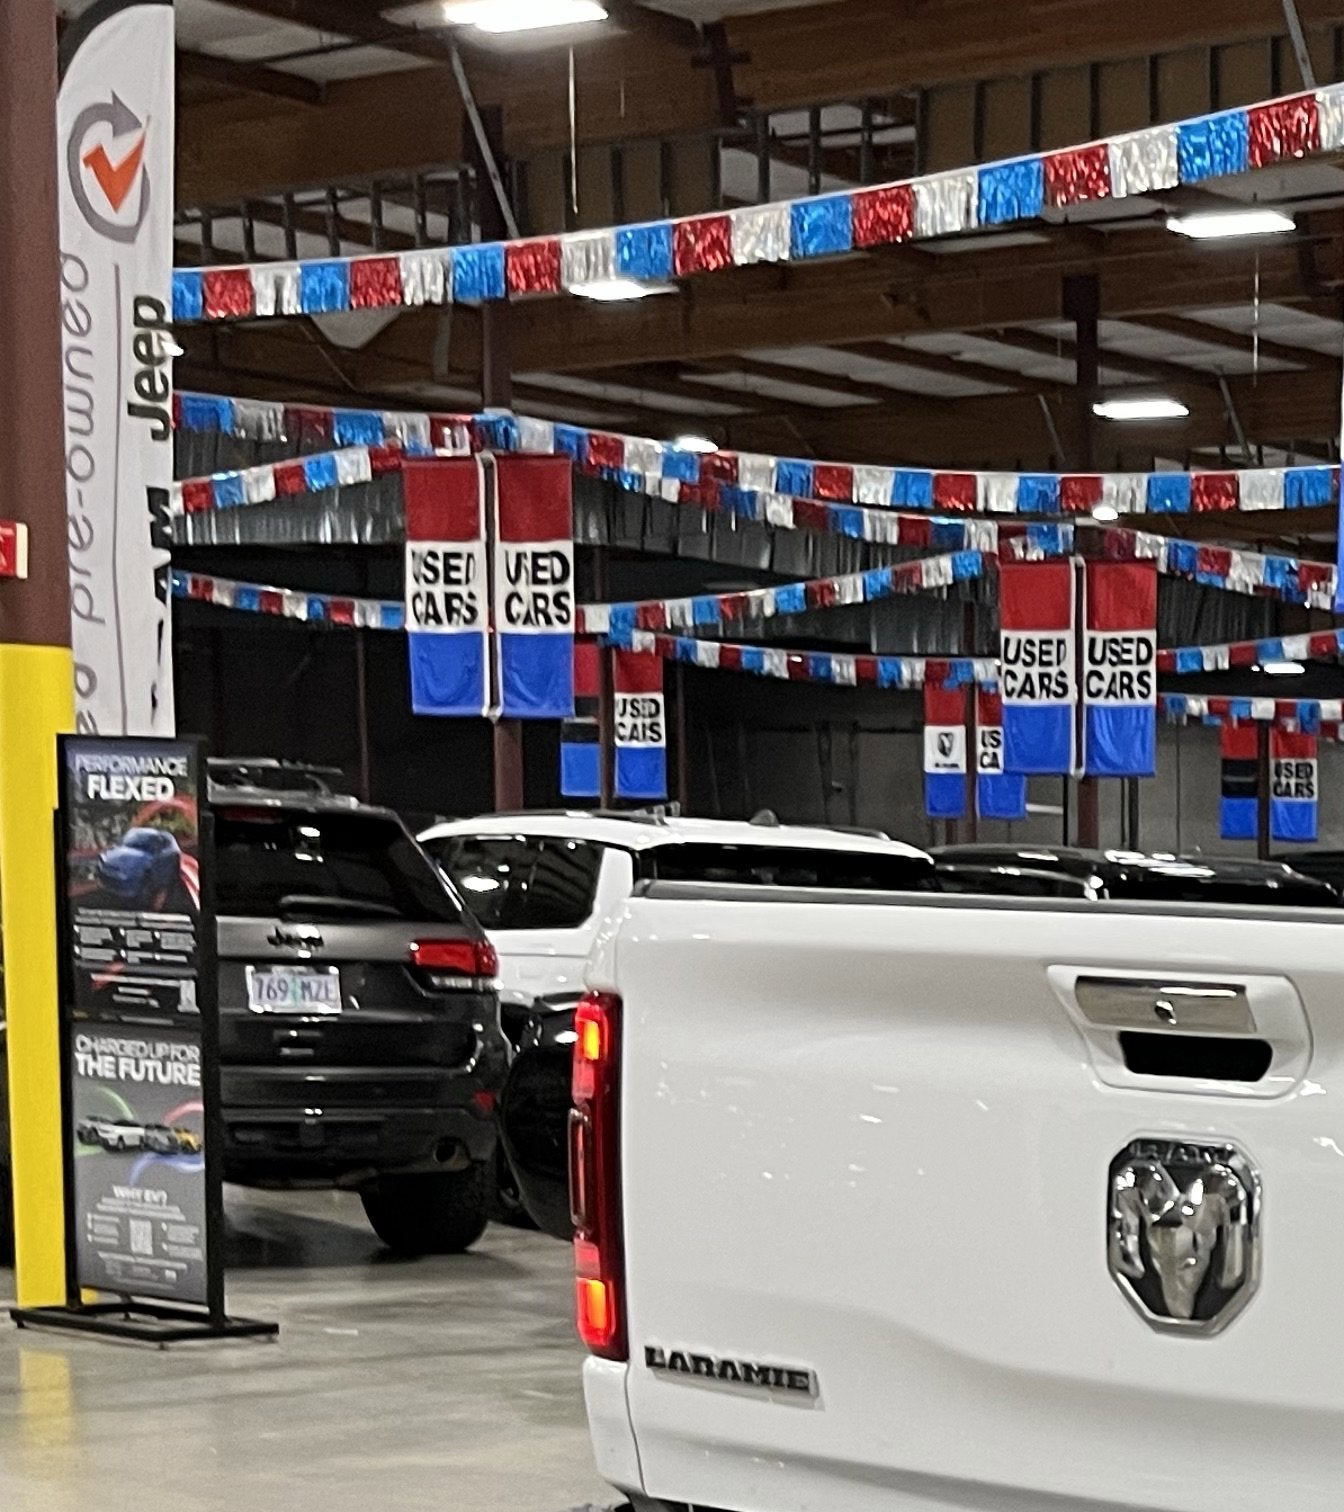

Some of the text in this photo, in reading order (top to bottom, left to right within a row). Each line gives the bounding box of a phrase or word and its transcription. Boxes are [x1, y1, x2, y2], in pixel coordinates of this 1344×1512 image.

[127, 295, 174, 441] Jeep
[412, 591, 478, 626] CARS
[1003, 636, 1067, 667] USED
[1088, 636, 1153, 667] USED
[1003, 669, 1069, 699] CARS
[1086, 669, 1151, 699] CARS
[1274, 762, 1314, 779] USED
[87, 773, 175, 802] FLEXED
[1273, 781, 1315, 798] CARS
[75, 1051, 201, 1087] THE FUTURE
[644, 1345, 820, 1399] LARAMIE
